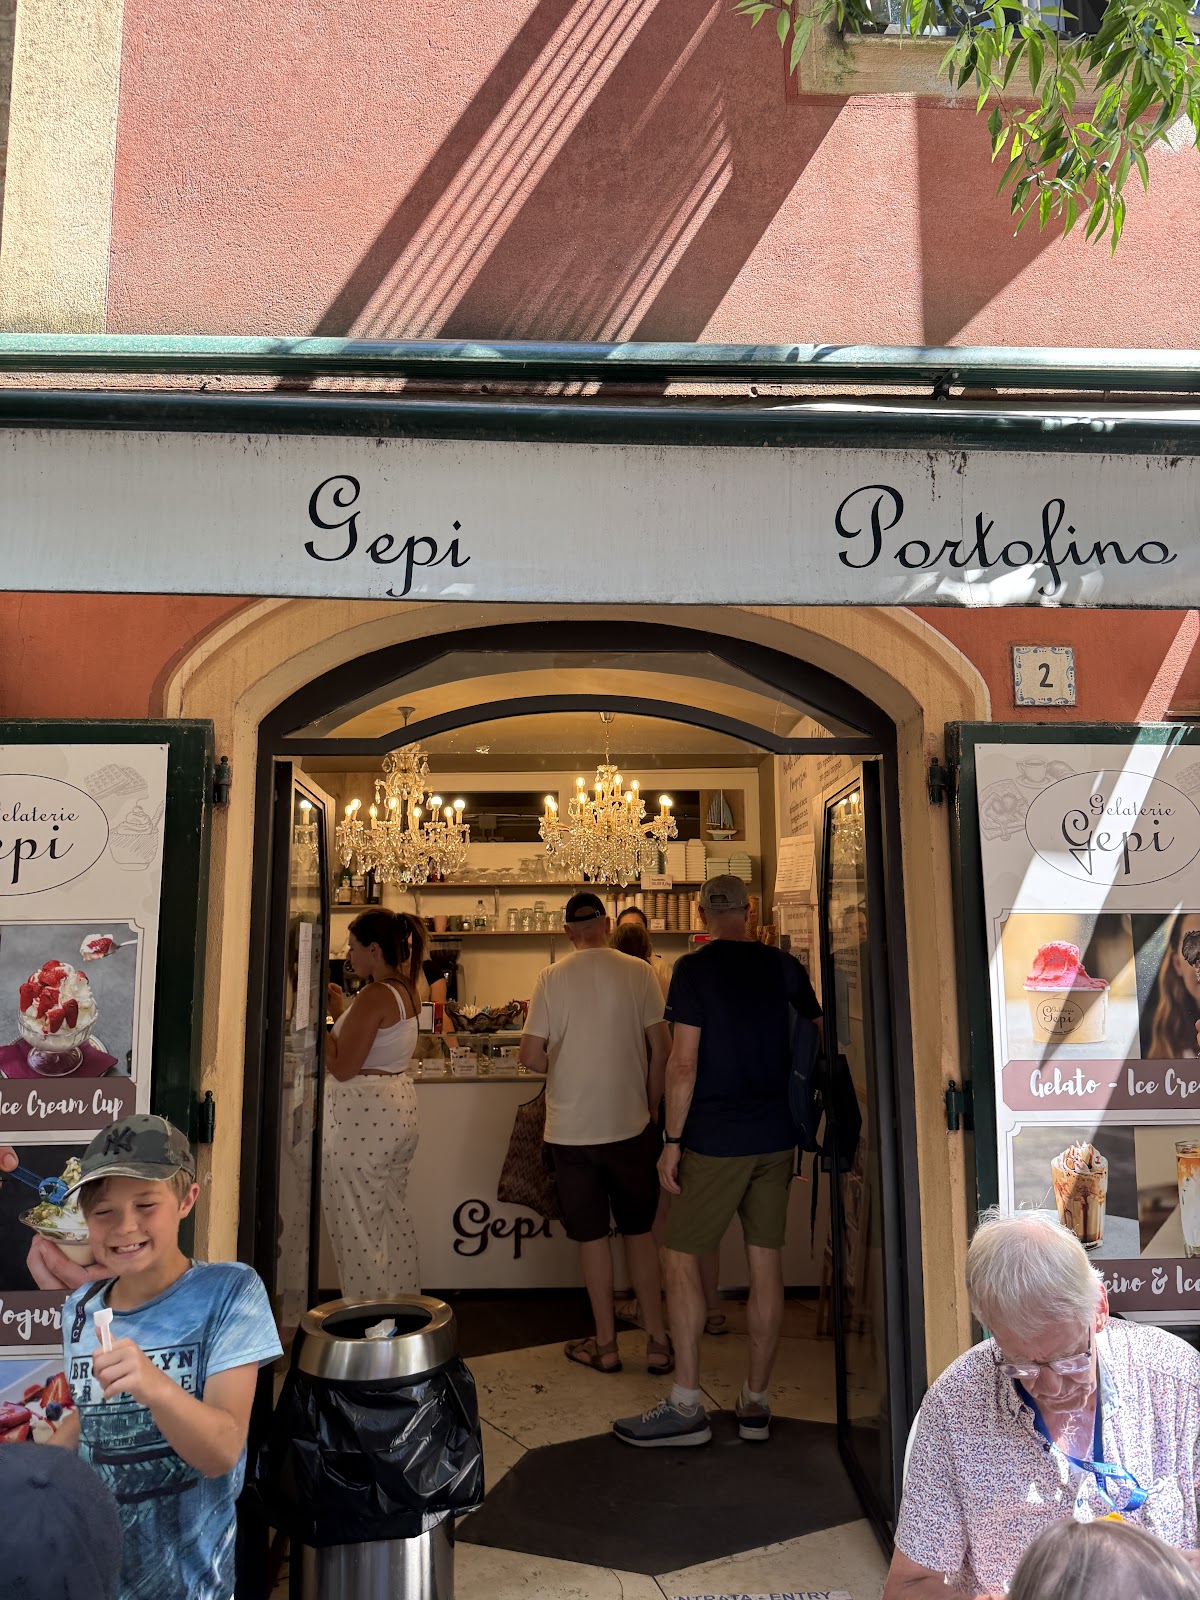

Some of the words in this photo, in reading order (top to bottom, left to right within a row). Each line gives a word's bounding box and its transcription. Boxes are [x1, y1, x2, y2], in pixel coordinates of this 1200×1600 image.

[304, 475, 471, 597] Gepi
[835, 484, 1177, 596] Portofino
[1039, 663, 1053, 687] 2
[0, 802, 79, 821] elaterie
[1089, 794, 1175, 815] Gelaterie
[0, 825, 74, 884] pi
[1062, 809, 1174, 875] Gepi
[1043, 1006, 1075, 1028] Gepi
[1030, 1068, 1101, 1098] Gelato
[1128, 1068, 1159, 1096] Ice
[1165, 1068, 1200, 1098] Cre
[27, 1090, 88, 1119] Cream
[93, 1089, 123, 1121] Cup
[1151, 1267, 1168, 1294] &
[0, 1296, 69, 1340] ogur
